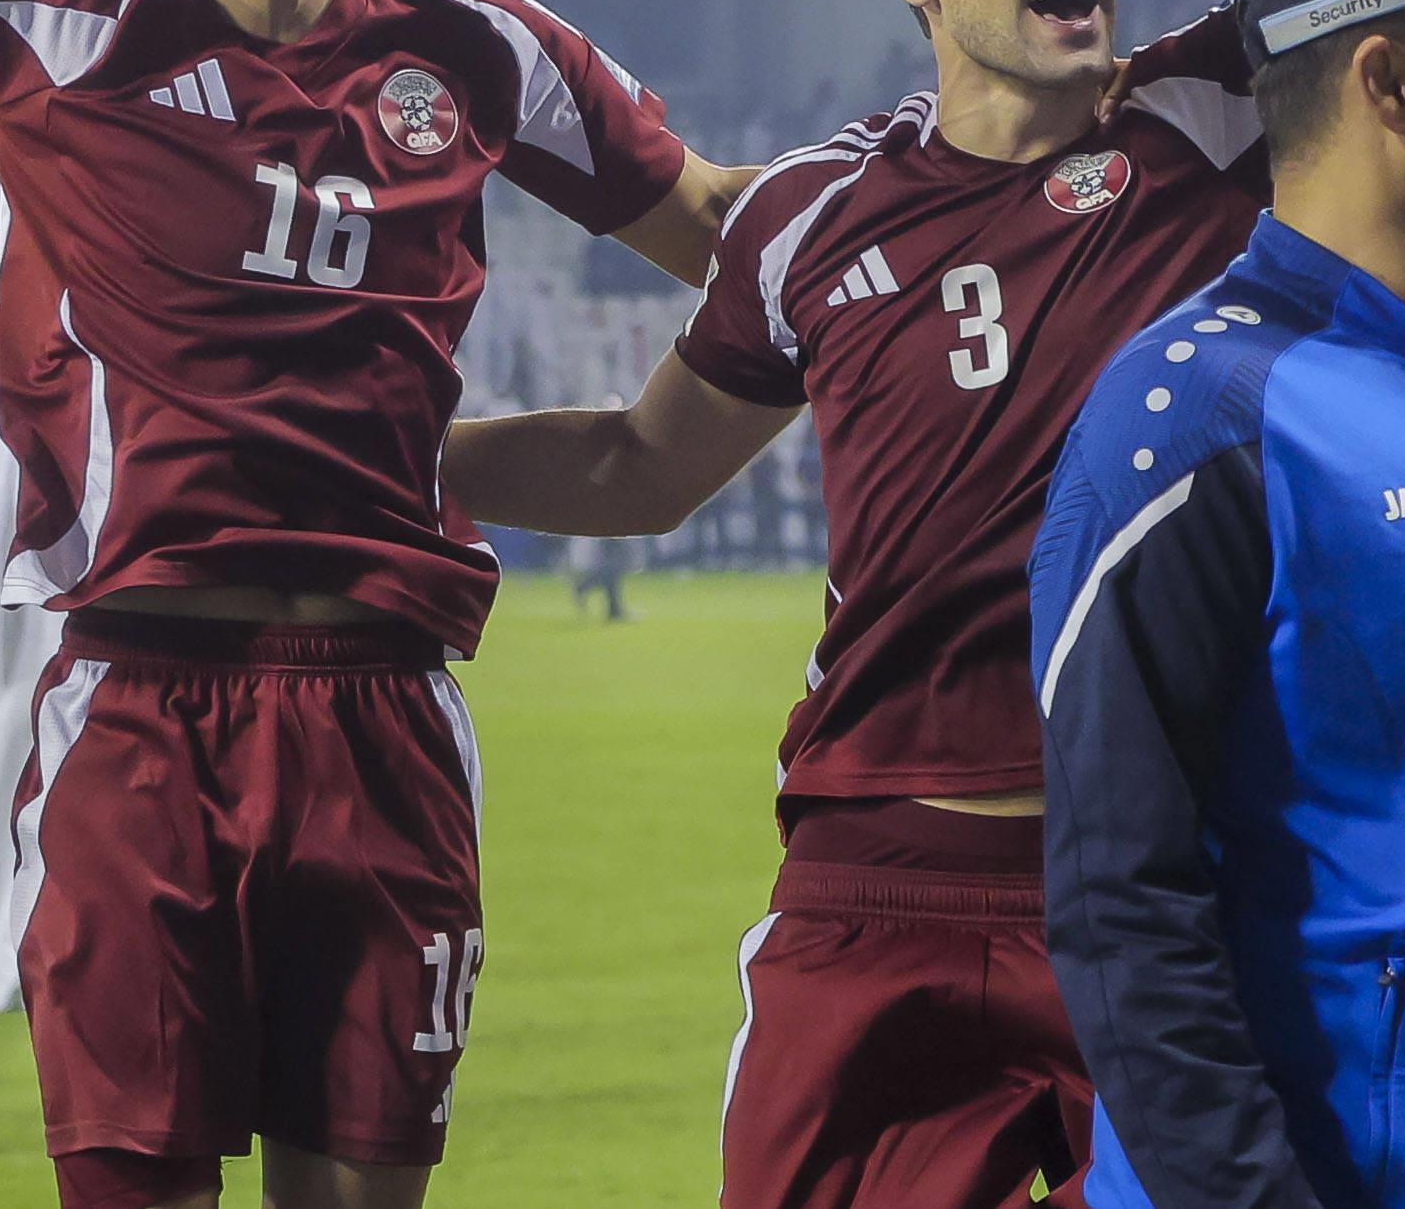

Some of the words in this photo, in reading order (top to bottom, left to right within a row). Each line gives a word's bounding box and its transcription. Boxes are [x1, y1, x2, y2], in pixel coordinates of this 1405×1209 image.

[406, 132, 443, 148] QFA
[241, 161, 376, 289] 16
[1075, 189, 1115, 209] QFA
[940, 263, 1010, 390] 3
